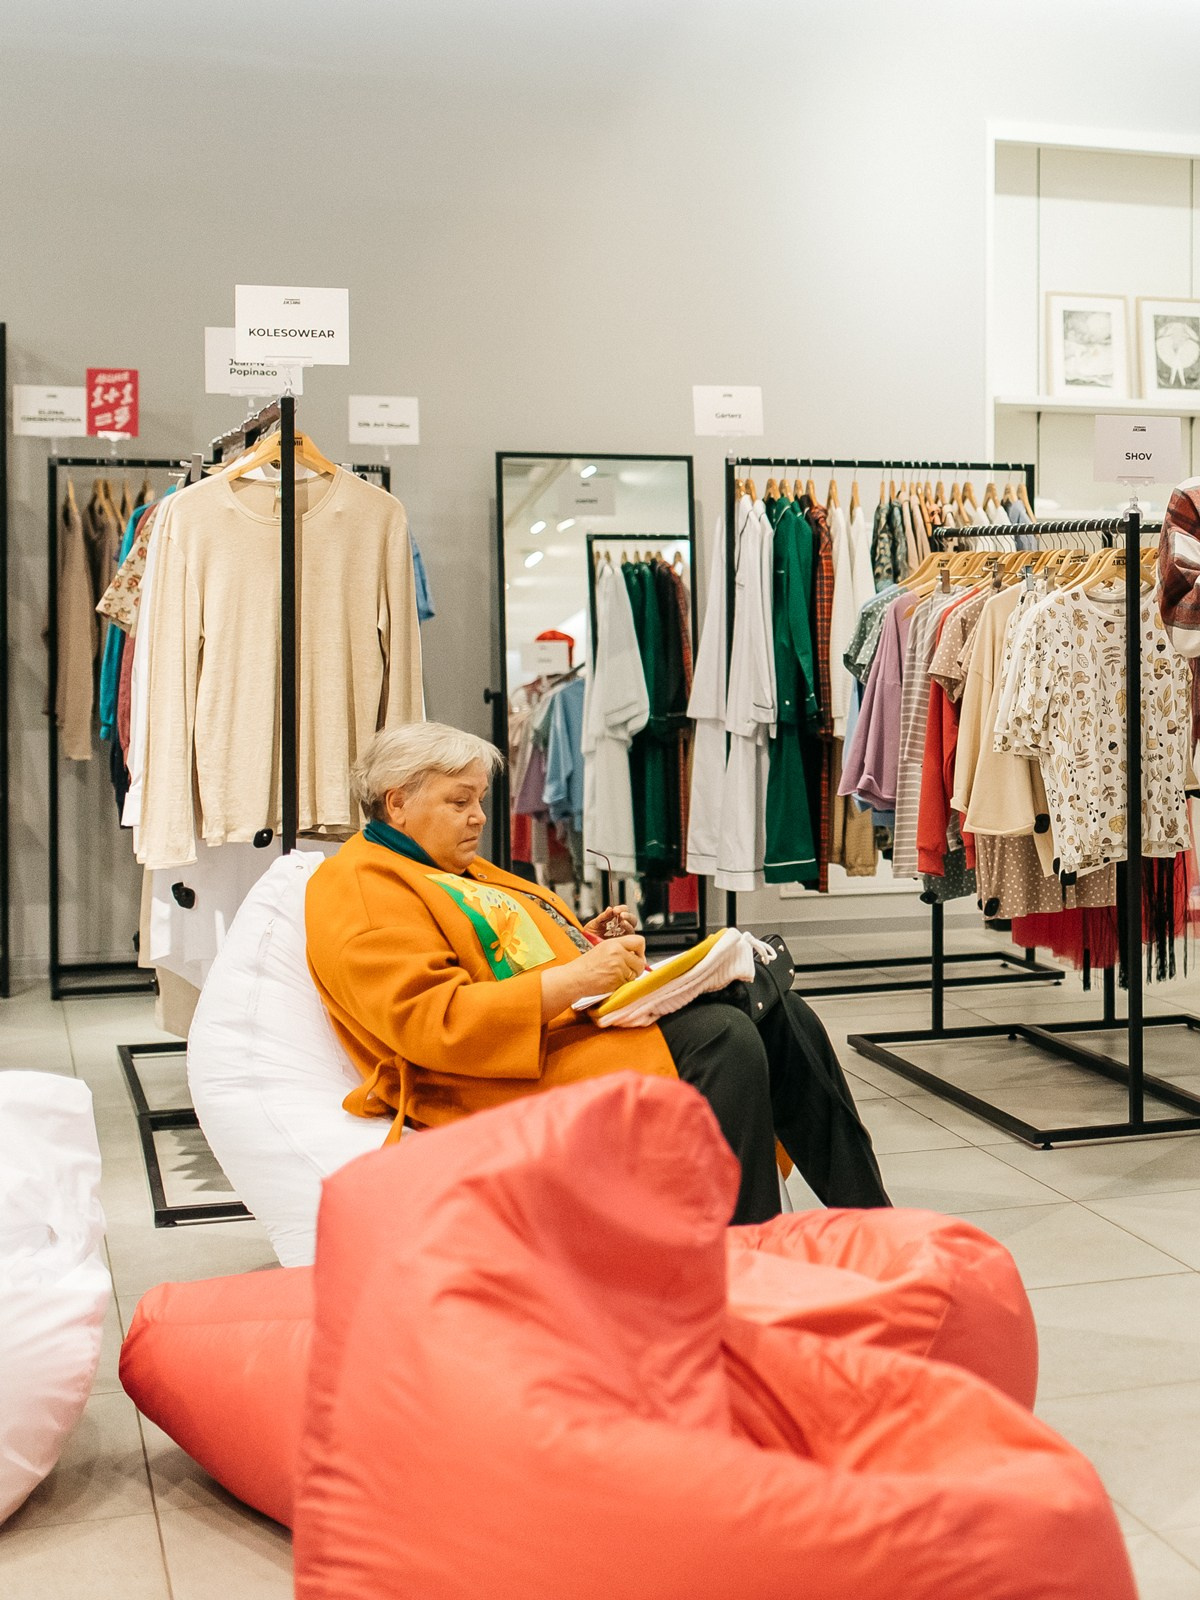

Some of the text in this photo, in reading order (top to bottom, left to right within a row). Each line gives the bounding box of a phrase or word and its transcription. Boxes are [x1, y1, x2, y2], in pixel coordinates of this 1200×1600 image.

[248, 328, 335, 338] KOLESOWEAR
[229, 368, 278, 377] Popinaco
[1125, 452, 1152, 460] SHOV
